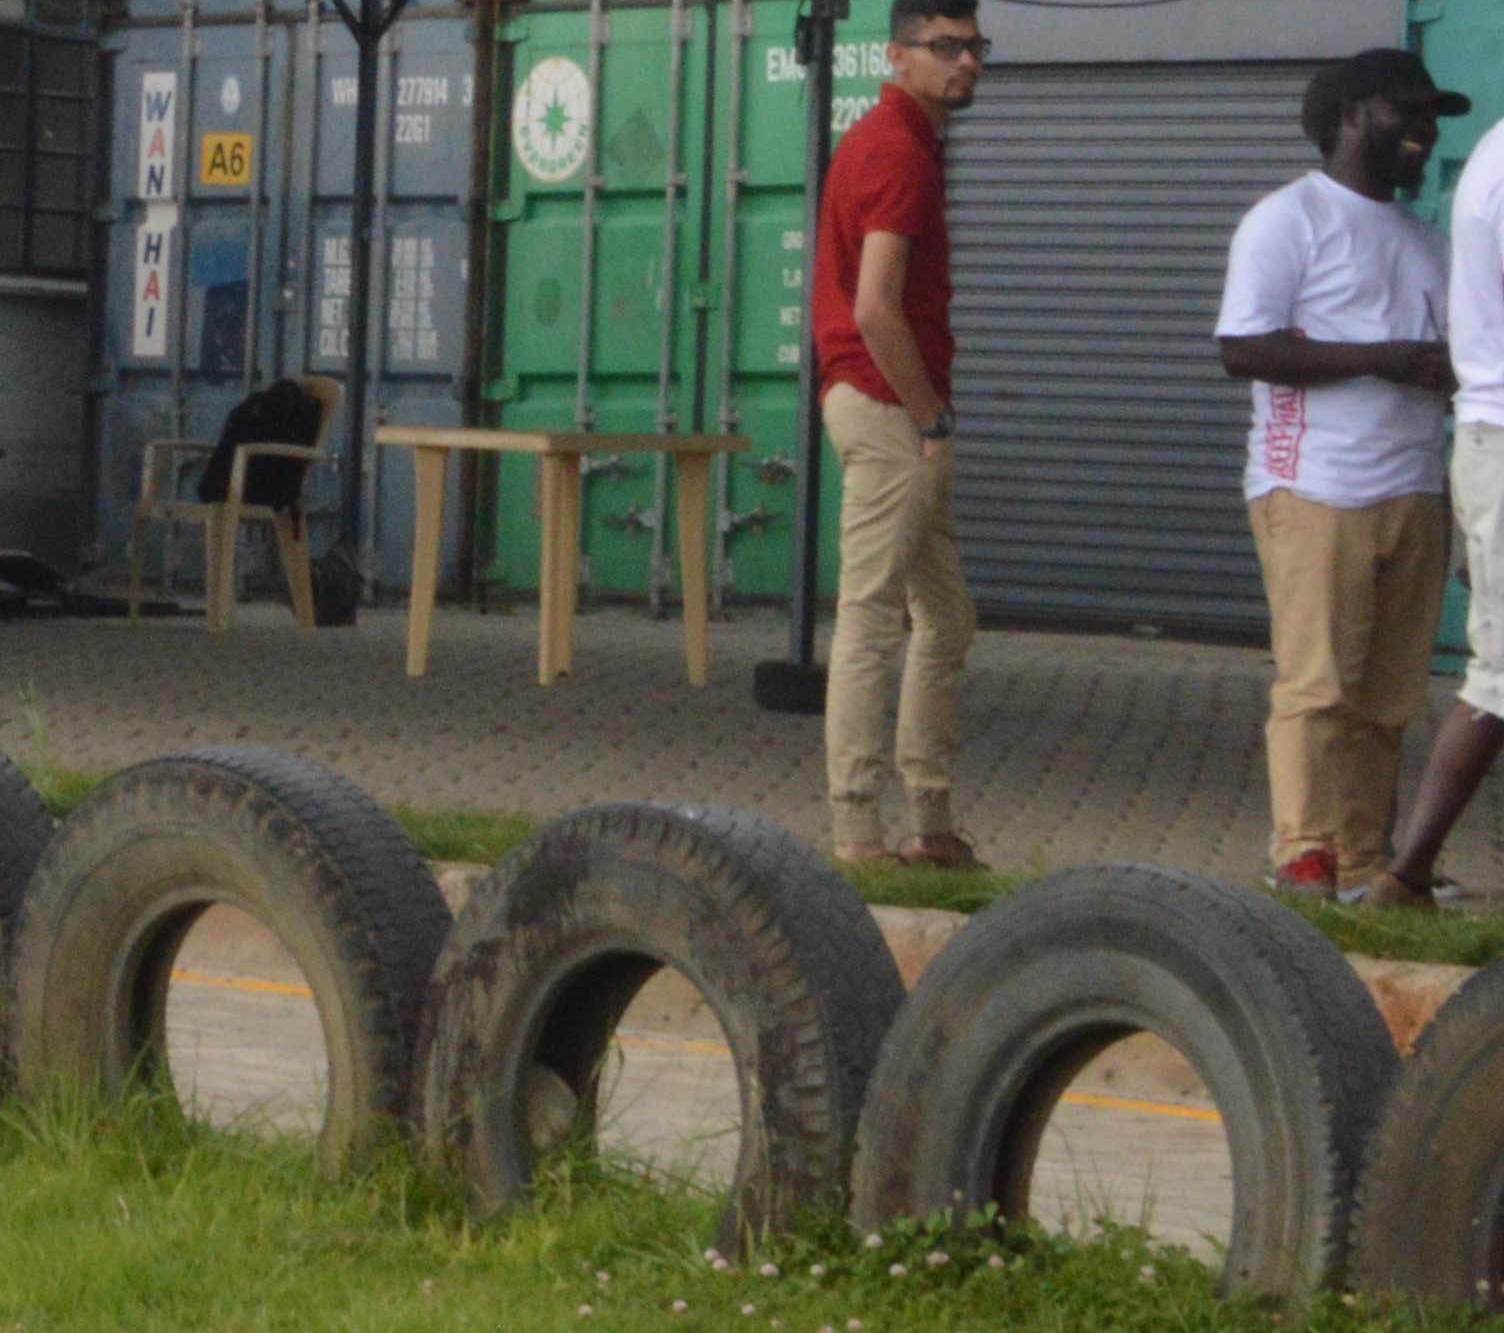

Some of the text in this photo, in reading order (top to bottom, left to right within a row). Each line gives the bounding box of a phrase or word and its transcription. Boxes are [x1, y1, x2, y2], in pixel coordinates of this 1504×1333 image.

[332, 76, 359, 106] WH
[146, 90, 172, 196] WAN
[208, 141, 245, 178] A6
[143, 233, 164, 338] HAI
